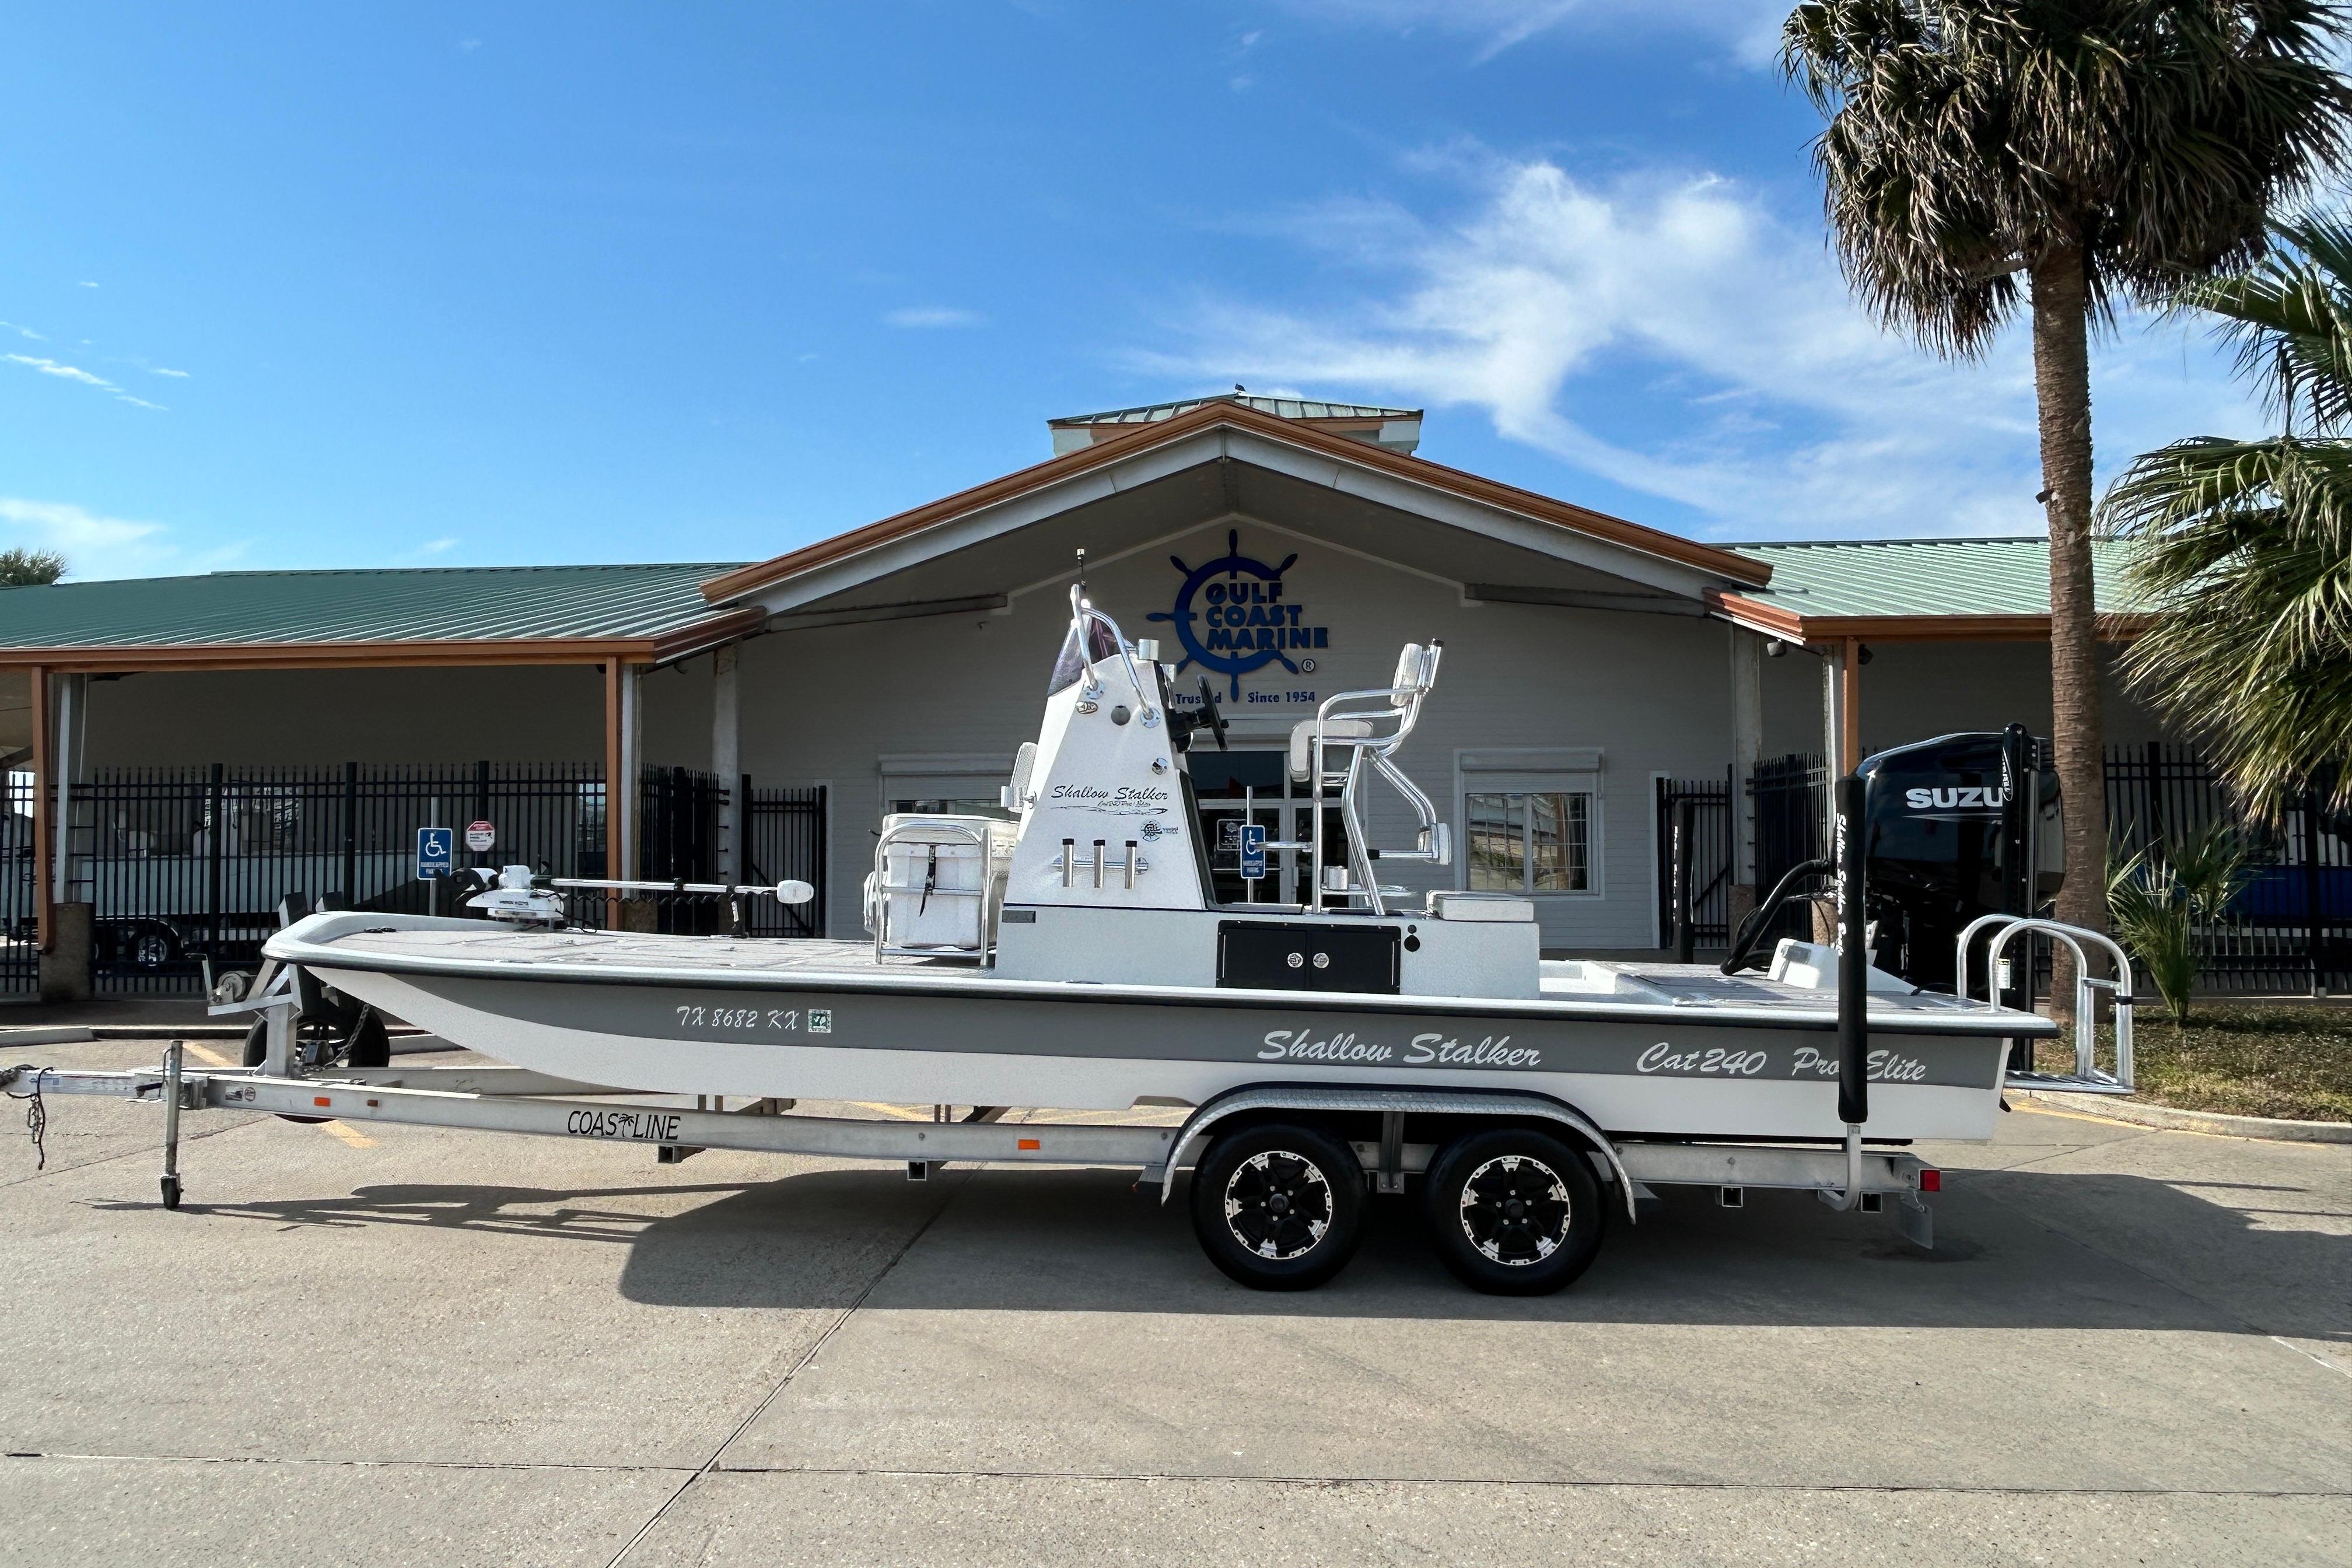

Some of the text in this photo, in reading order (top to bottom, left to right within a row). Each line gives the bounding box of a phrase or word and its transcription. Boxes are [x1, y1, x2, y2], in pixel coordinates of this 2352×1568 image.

[1205, 583, 1282, 604] GULF
[1206, 604, 1302, 628] COAST
[1206, 627, 1328, 650] MARINE
[1175, 691, 1315, 704] Trusd Since 1954
[1051, 785, 1168, 800] Shallow Stalker
[1906, 788, 2003, 808] SUZU
[677, 1006, 706, 1026] TX
[712, 1008, 758, 1027] 8682
[768, 1010, 799, 1030] KX
[1257, 1029, 1541, 1066] Shallow Stalker
[1792, 1047, 1839, 1076] Pro
[1867, 1050, 1926, 1080] Elite
